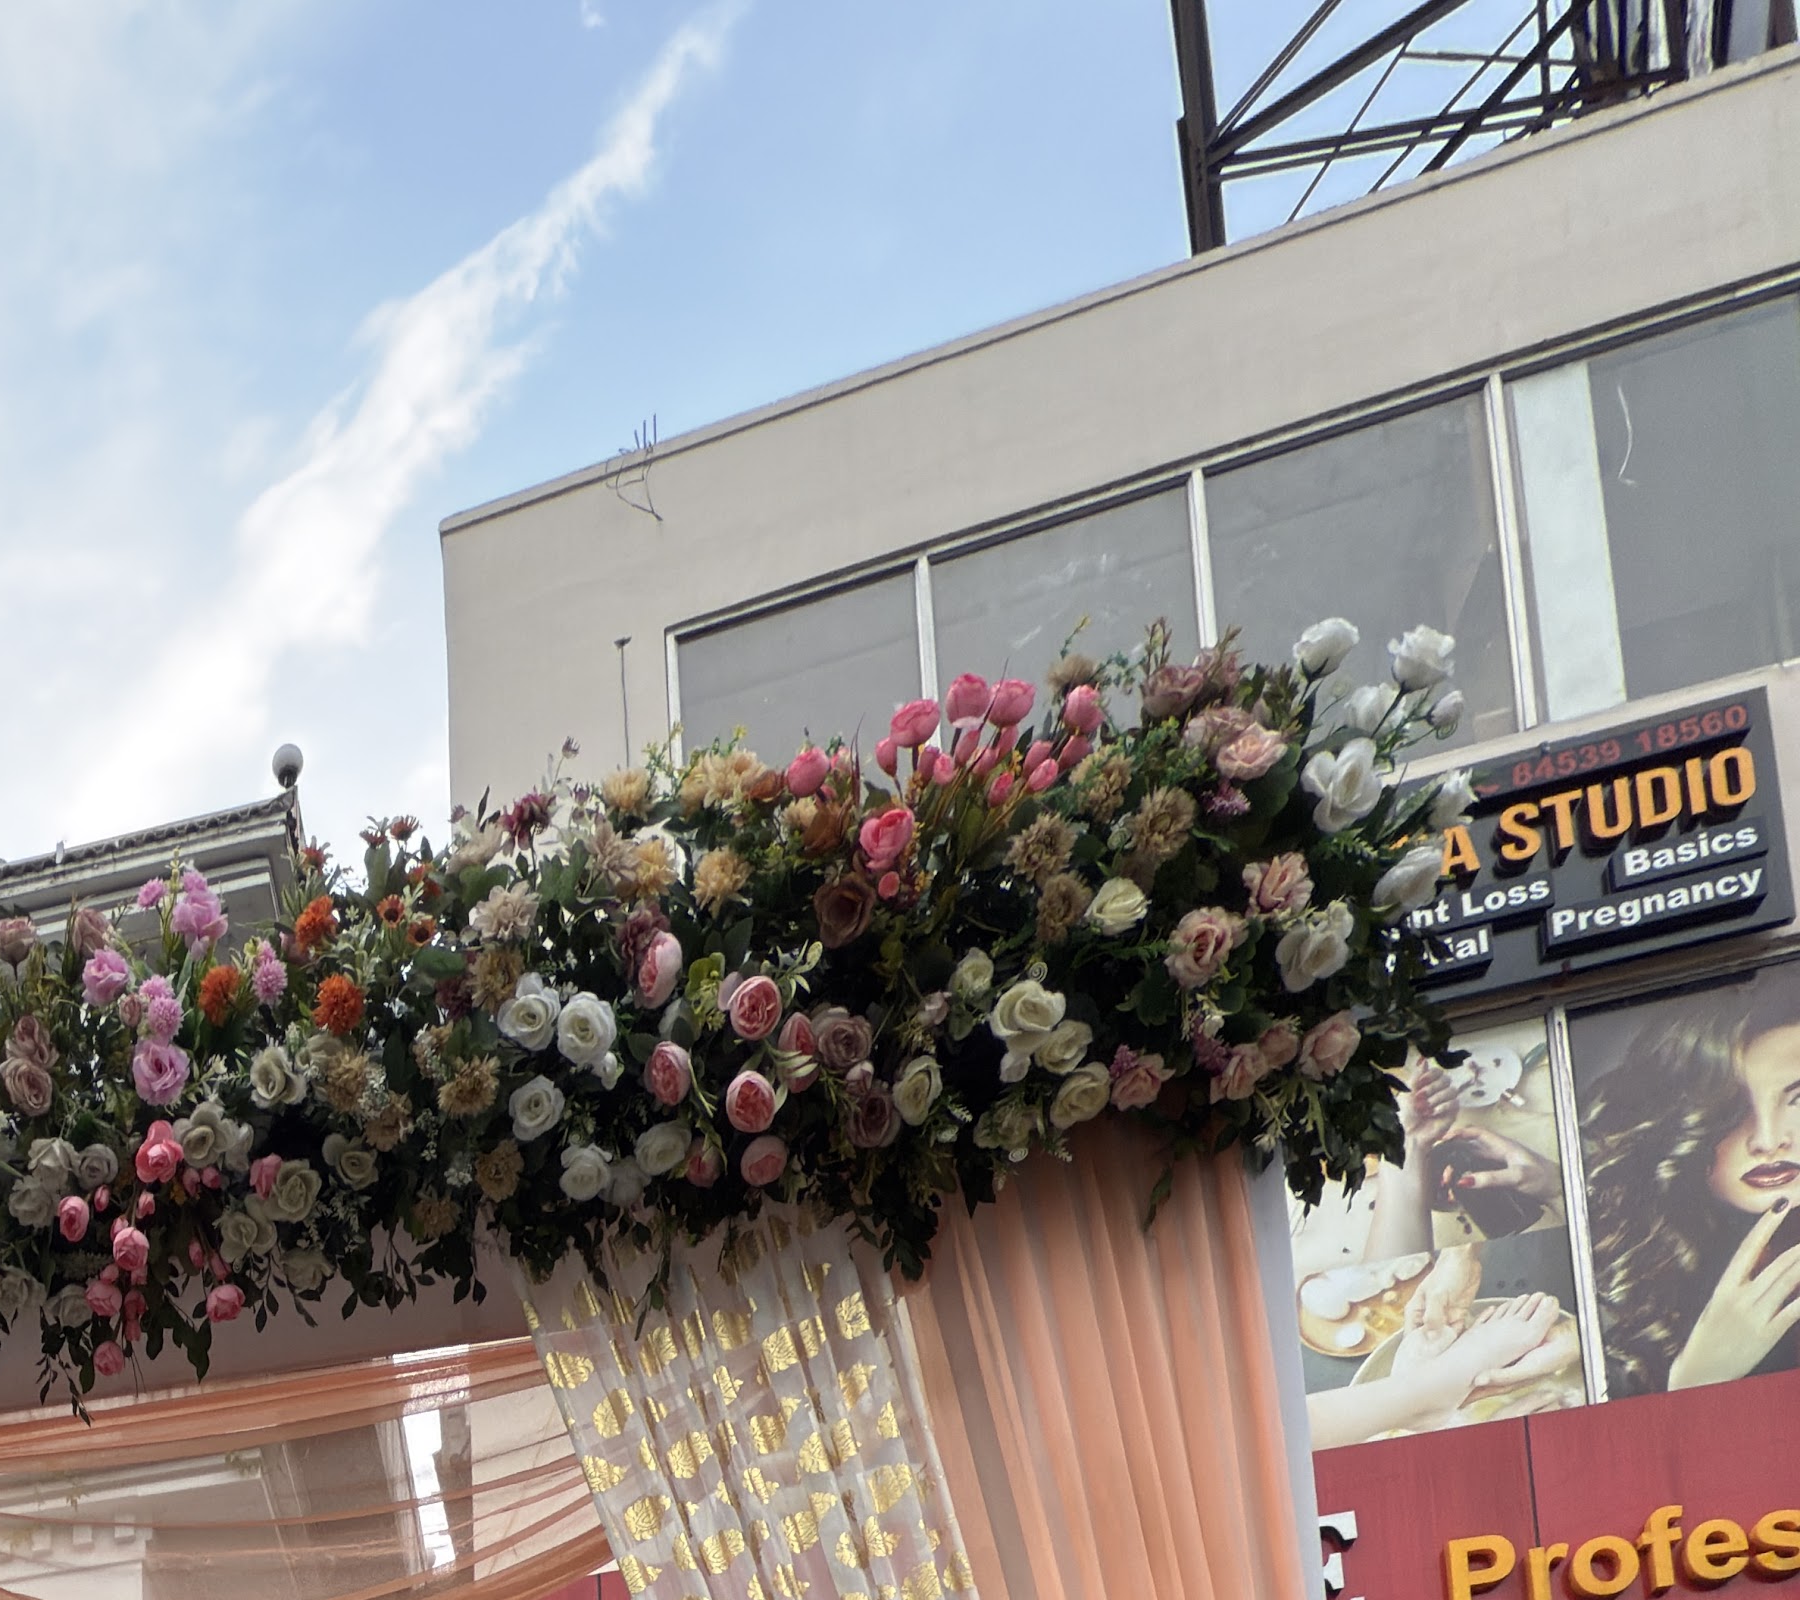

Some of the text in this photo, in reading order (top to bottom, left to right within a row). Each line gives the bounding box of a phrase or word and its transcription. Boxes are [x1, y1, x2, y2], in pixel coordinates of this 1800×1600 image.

[1511, 704, 1747, 787] 84539 18560
[1499, 747, 1757, 861] STUDIO
[1623, 824, 1759, 877] Basics
[1461, 880, 1550, 918] Loss
[1551, 867, 1763, 938] Pregnancy
